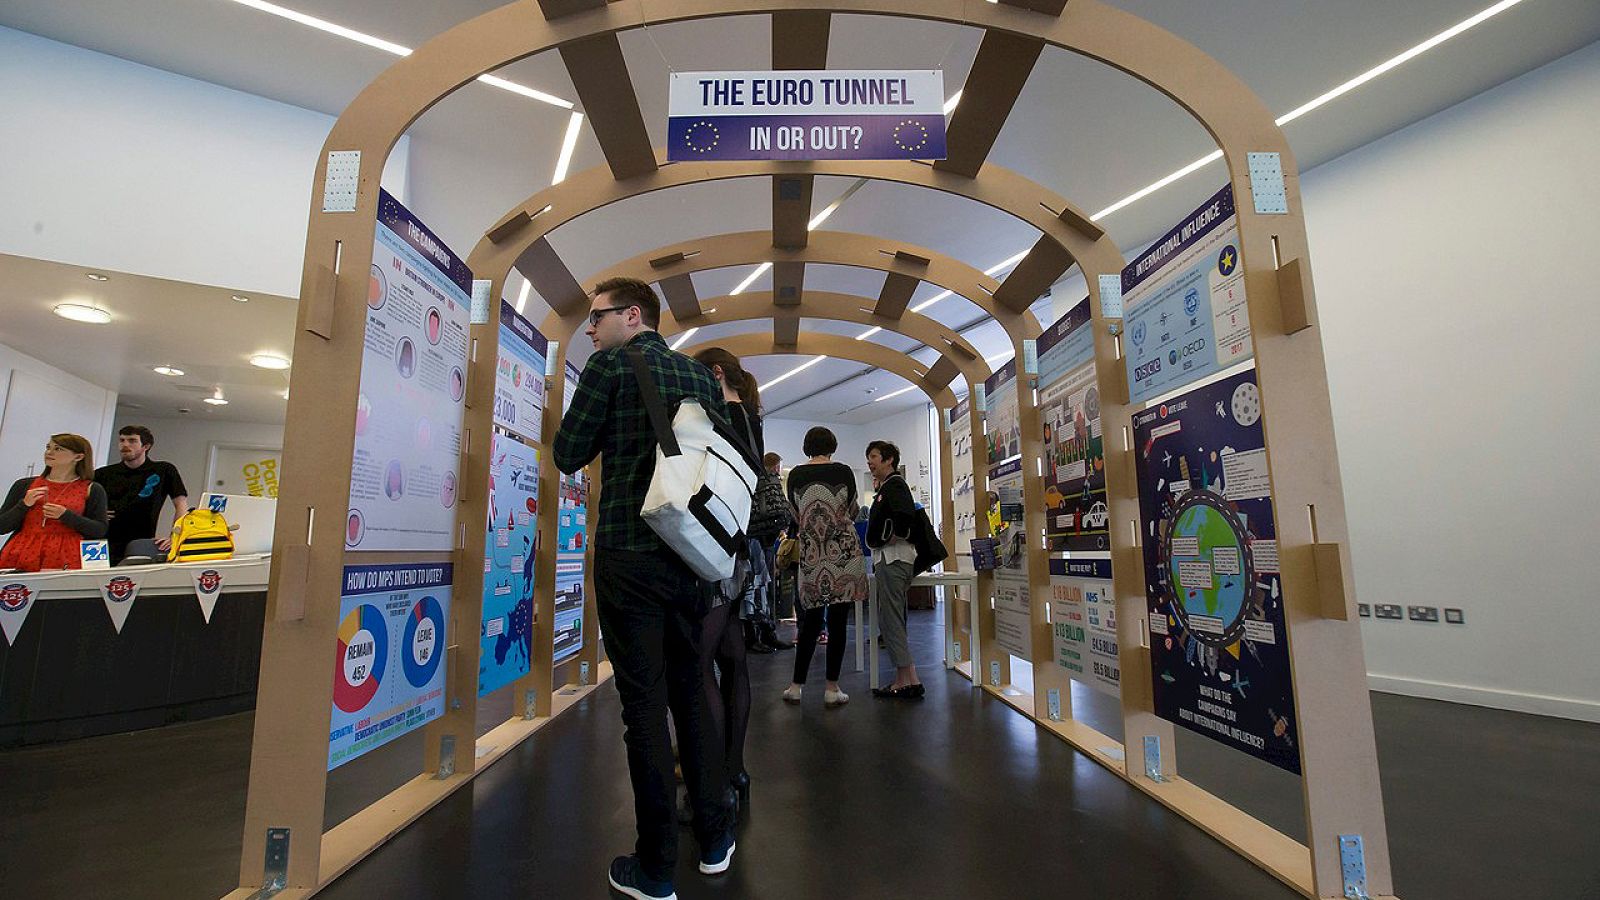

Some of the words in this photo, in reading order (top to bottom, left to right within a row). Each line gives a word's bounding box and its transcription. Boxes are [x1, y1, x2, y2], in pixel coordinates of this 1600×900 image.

[699, 80, 744, 106] THE
[752, 79, 813, 105] EURO
[820, 79, 914, 105] TUNNEL
[750, 127, 770, 150] IN
[777, 126, 804, 150] OR
[811, 126, 863, 149] OUT?
[1181, 201, 1220, 242] INFLUENCE
[1183, 338, 1206, 357] OECD
[347, 571, 367, 591] HOW
[367, 571, 377, 588] DO
[378, 570, 394, 587] MPS
[417, 569, 426, 584] TO
[426, 568, 443, 583] VOTE?
[1086, 591, 1098, 603] NHS
[417, 628, 432, 643] LEAVE
[347, 641, 373, 660] REMAIN
[352, 665, 366, 681] 452
